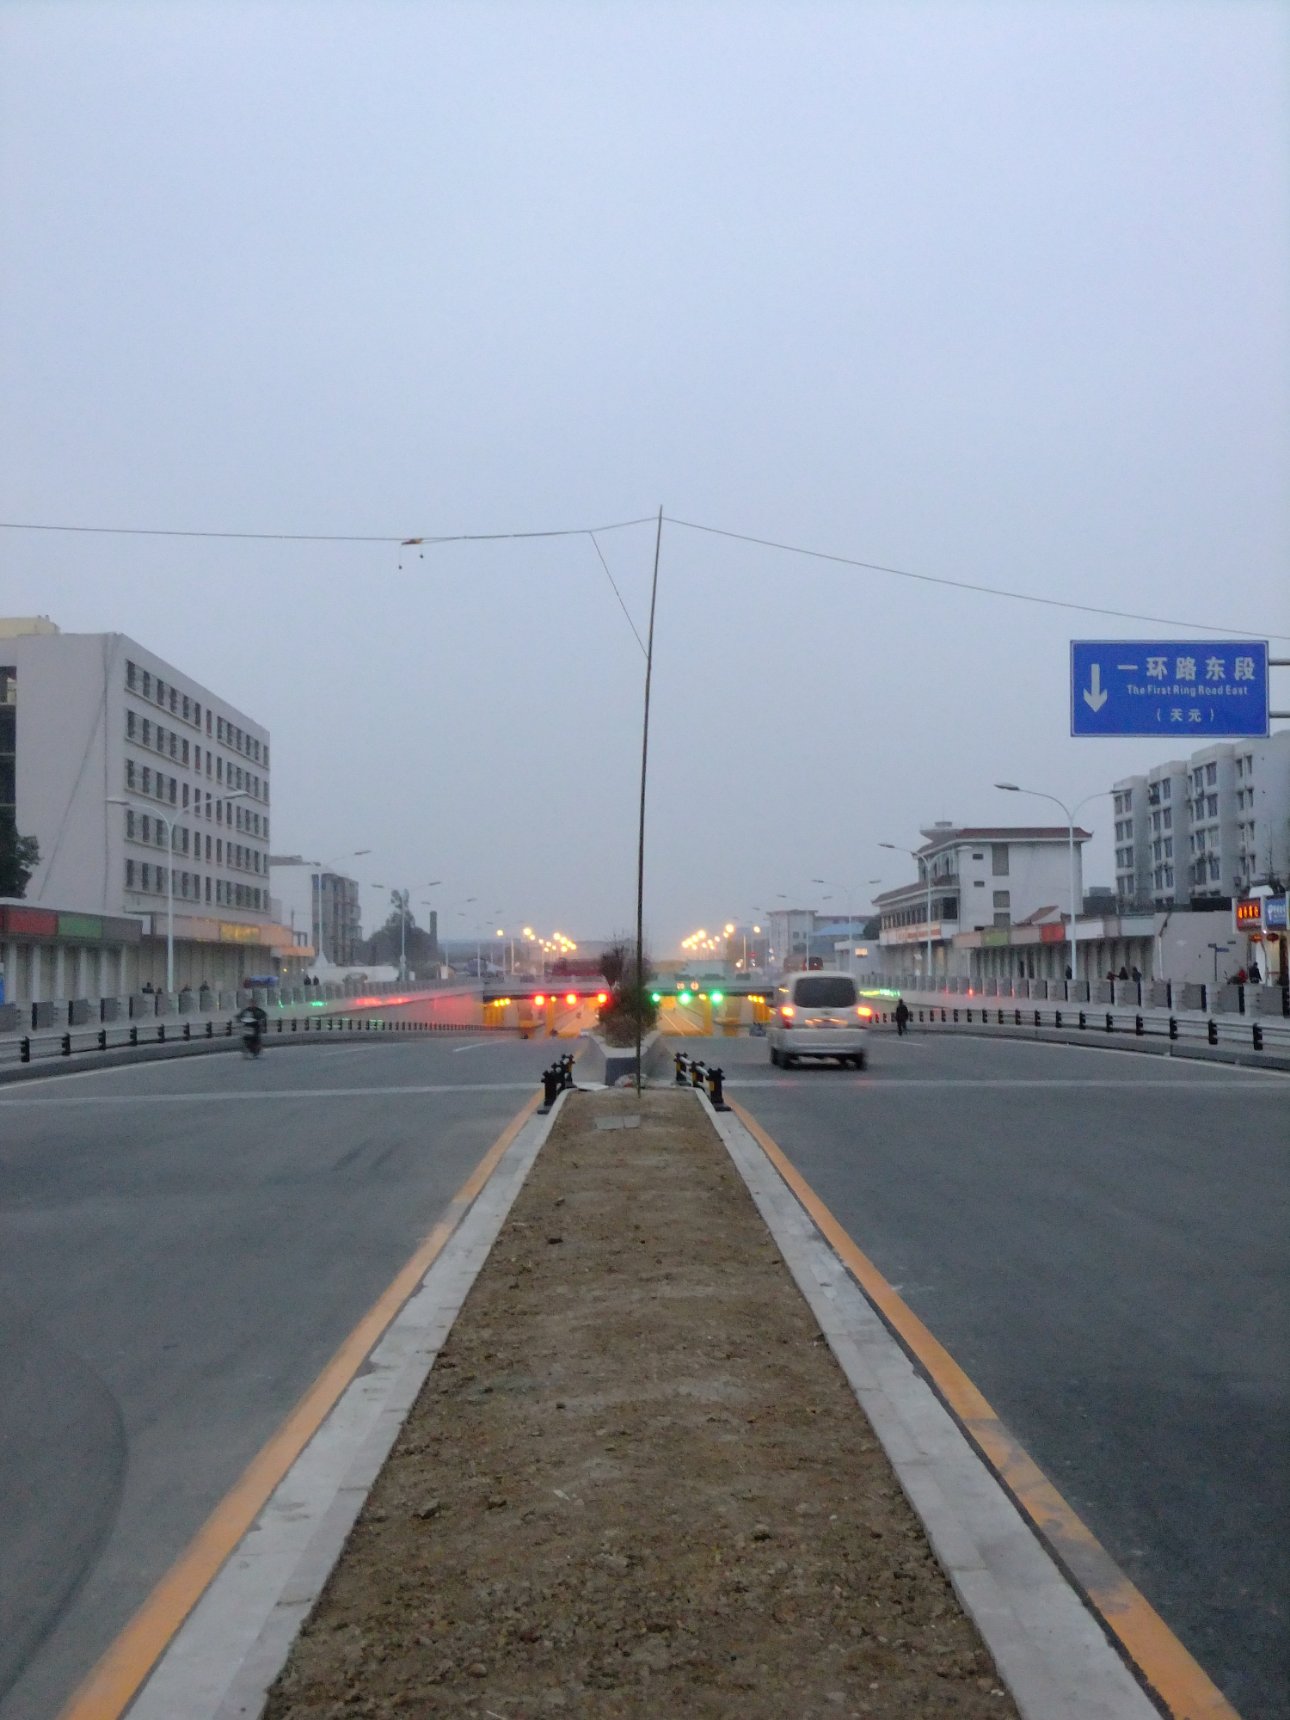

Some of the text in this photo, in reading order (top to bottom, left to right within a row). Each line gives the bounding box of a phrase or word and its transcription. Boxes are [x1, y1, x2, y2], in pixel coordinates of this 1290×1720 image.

[1118, 656, 1255, 680] 一环路东段
[1127, 685, 1248, 697] The First Ring Road East
